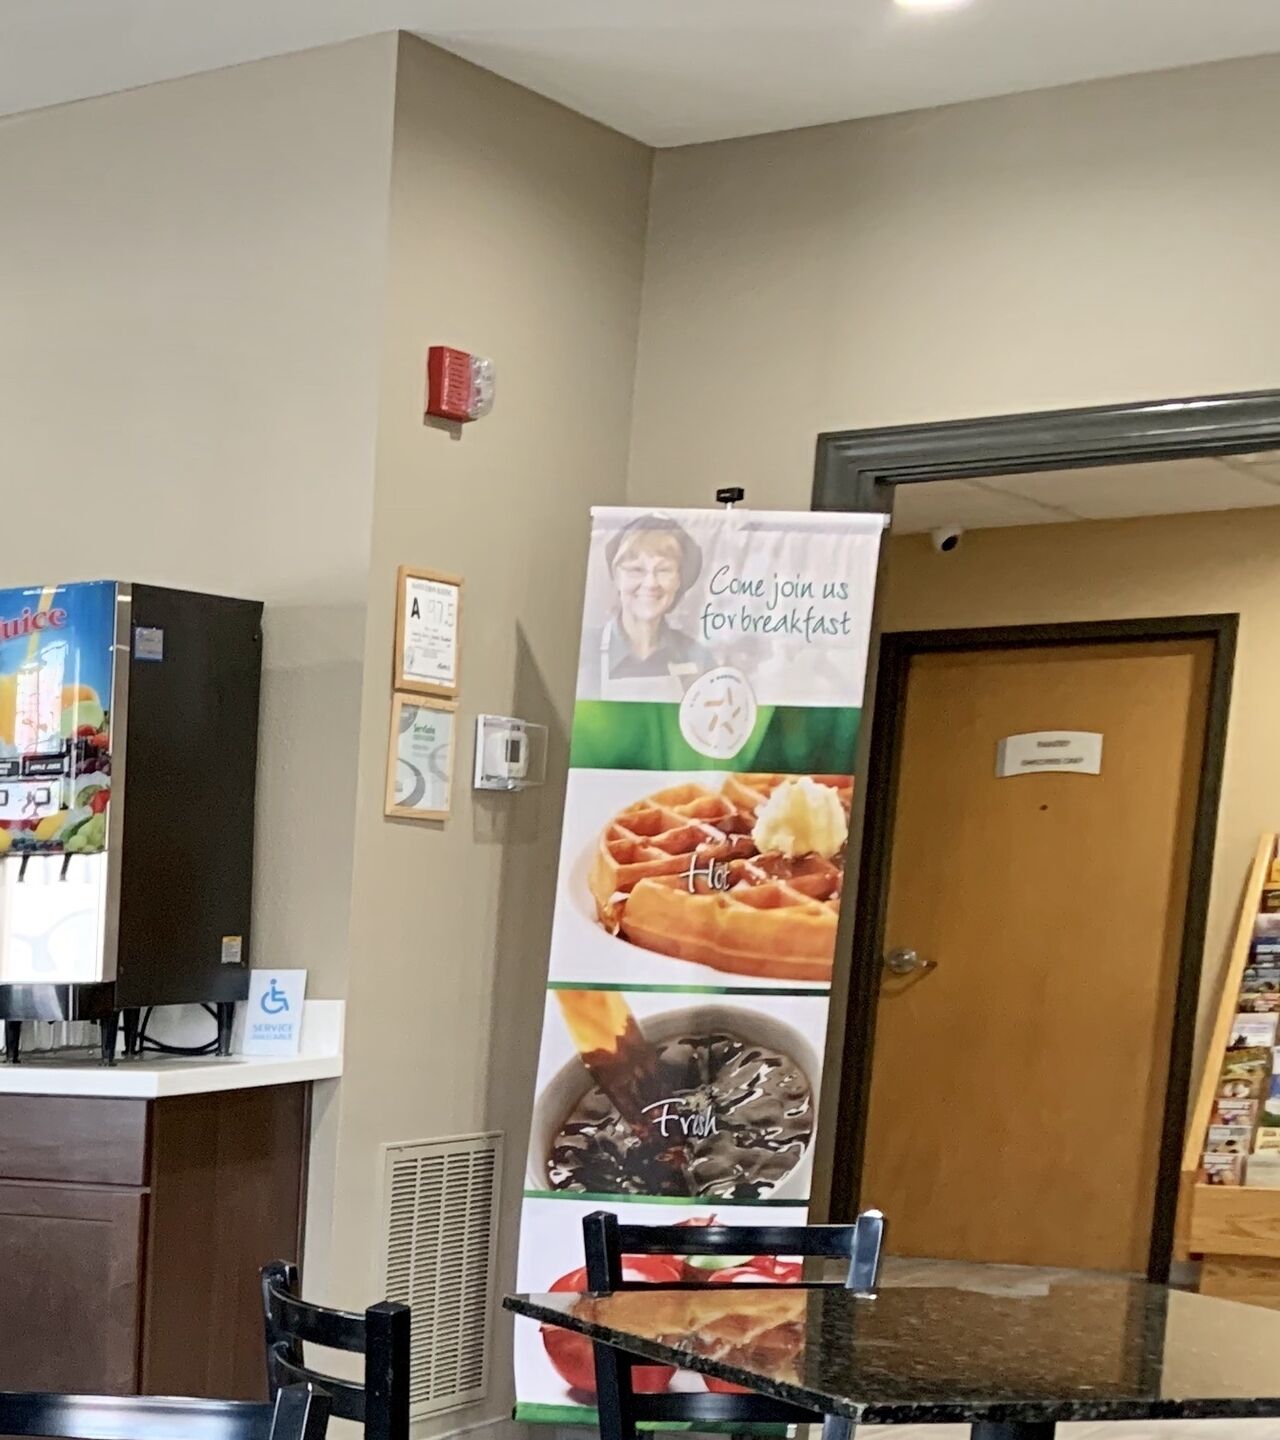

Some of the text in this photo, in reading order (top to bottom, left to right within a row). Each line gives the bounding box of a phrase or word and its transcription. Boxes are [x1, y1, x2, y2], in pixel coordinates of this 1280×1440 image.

[709, 564, 849, 611] Come join us
[410, 596, 421, 620] A
[700, 602, 852, 644] for breakfast
[679, 853, 731, 893] Hot
[252, 1023, 293, 1033] SERVICE
[641, 1097, 720, 1137] Fresh
